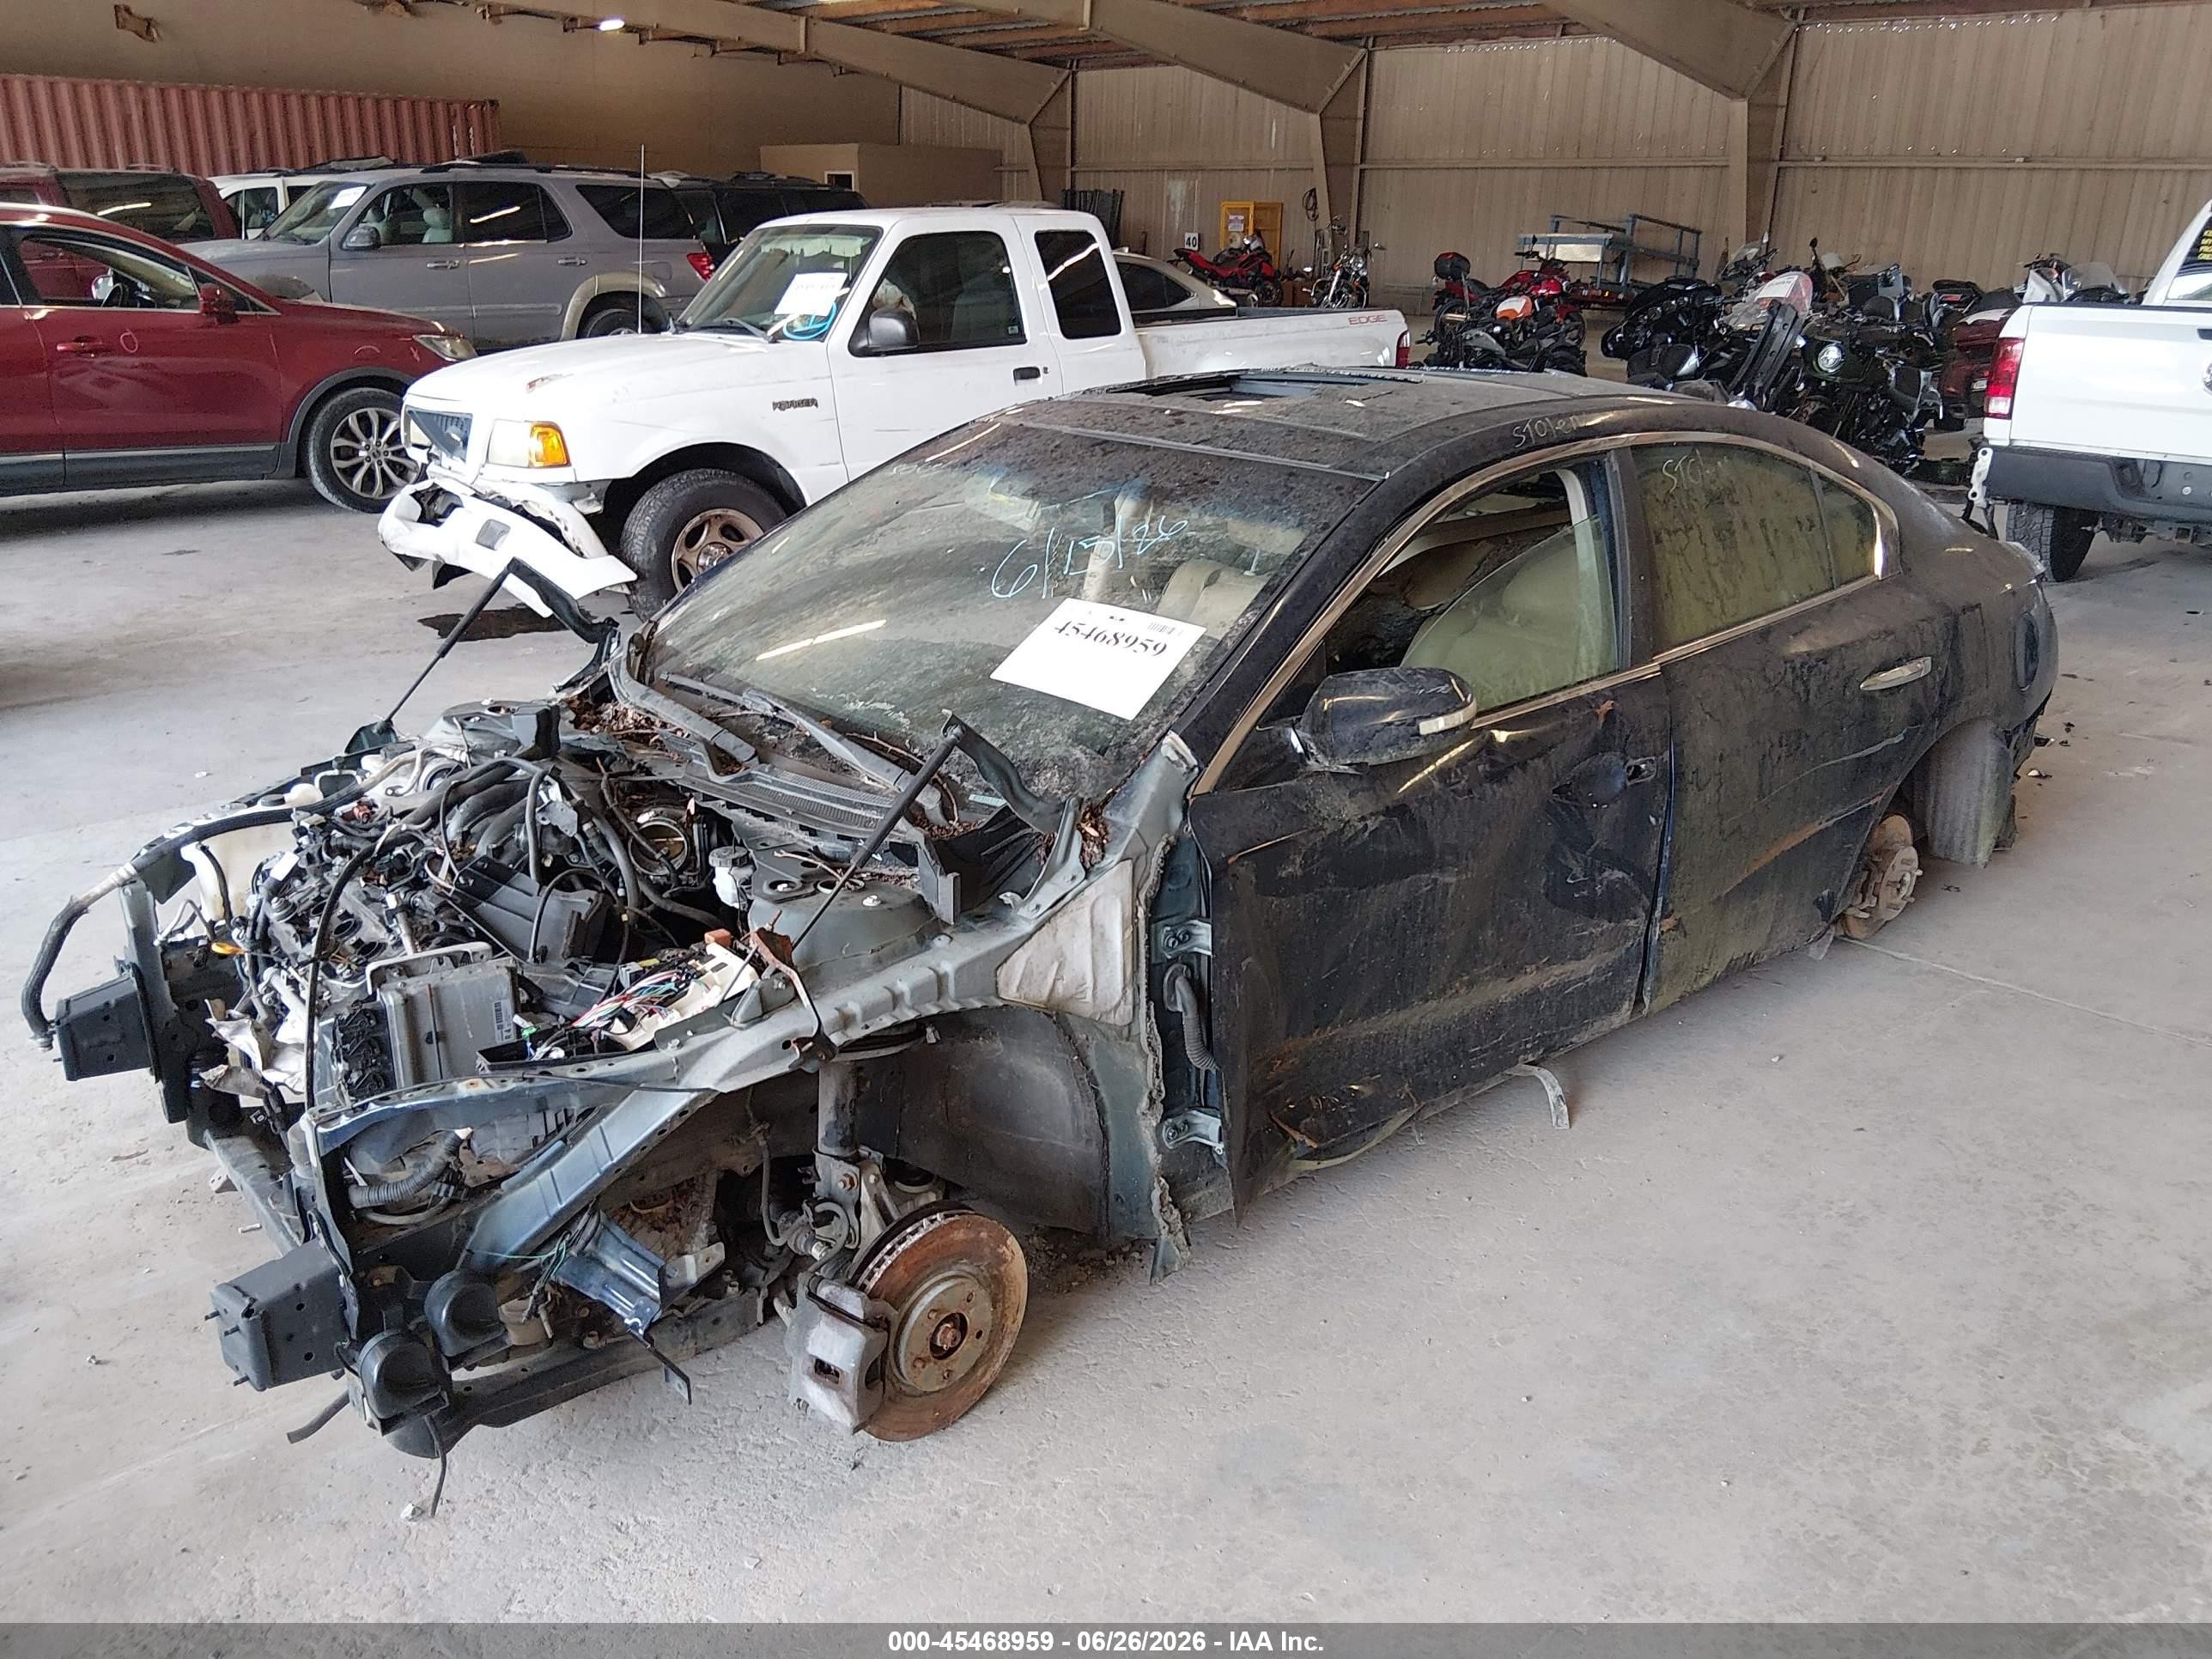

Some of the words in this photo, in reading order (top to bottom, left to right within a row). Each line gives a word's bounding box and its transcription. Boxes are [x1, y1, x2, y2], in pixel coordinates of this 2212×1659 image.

[1186, 236, 1197, 247] 40
[1347, 314, 1389, 325] EDGE
[1054, 620, 1168, 657] 45468959
